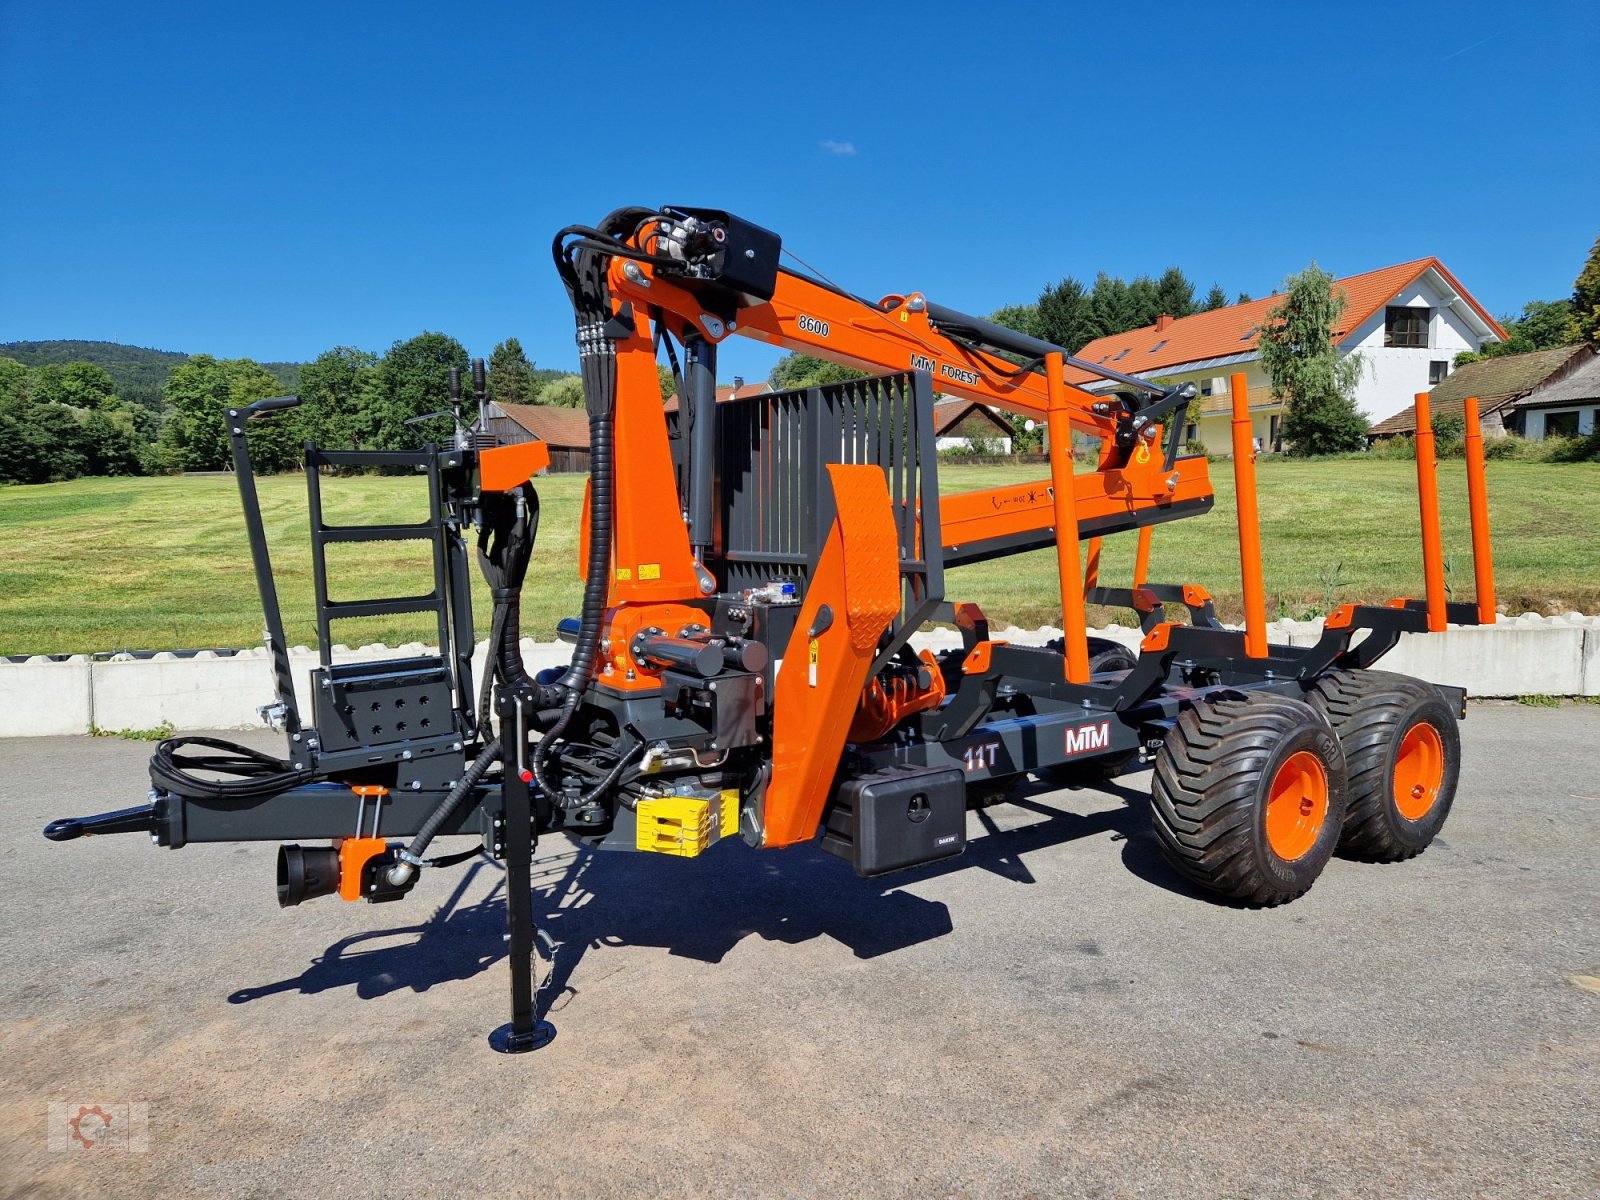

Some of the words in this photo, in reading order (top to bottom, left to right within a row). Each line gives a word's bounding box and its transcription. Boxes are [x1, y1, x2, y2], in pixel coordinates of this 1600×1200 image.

[798, 314, 830, 338] 8600
[910, 353, 937, 373] MTM
[940, 364, 981, 386] FOREST
[1064, 720, 1110, 755] MTM
[964, 741, 1000, 772] 11T
